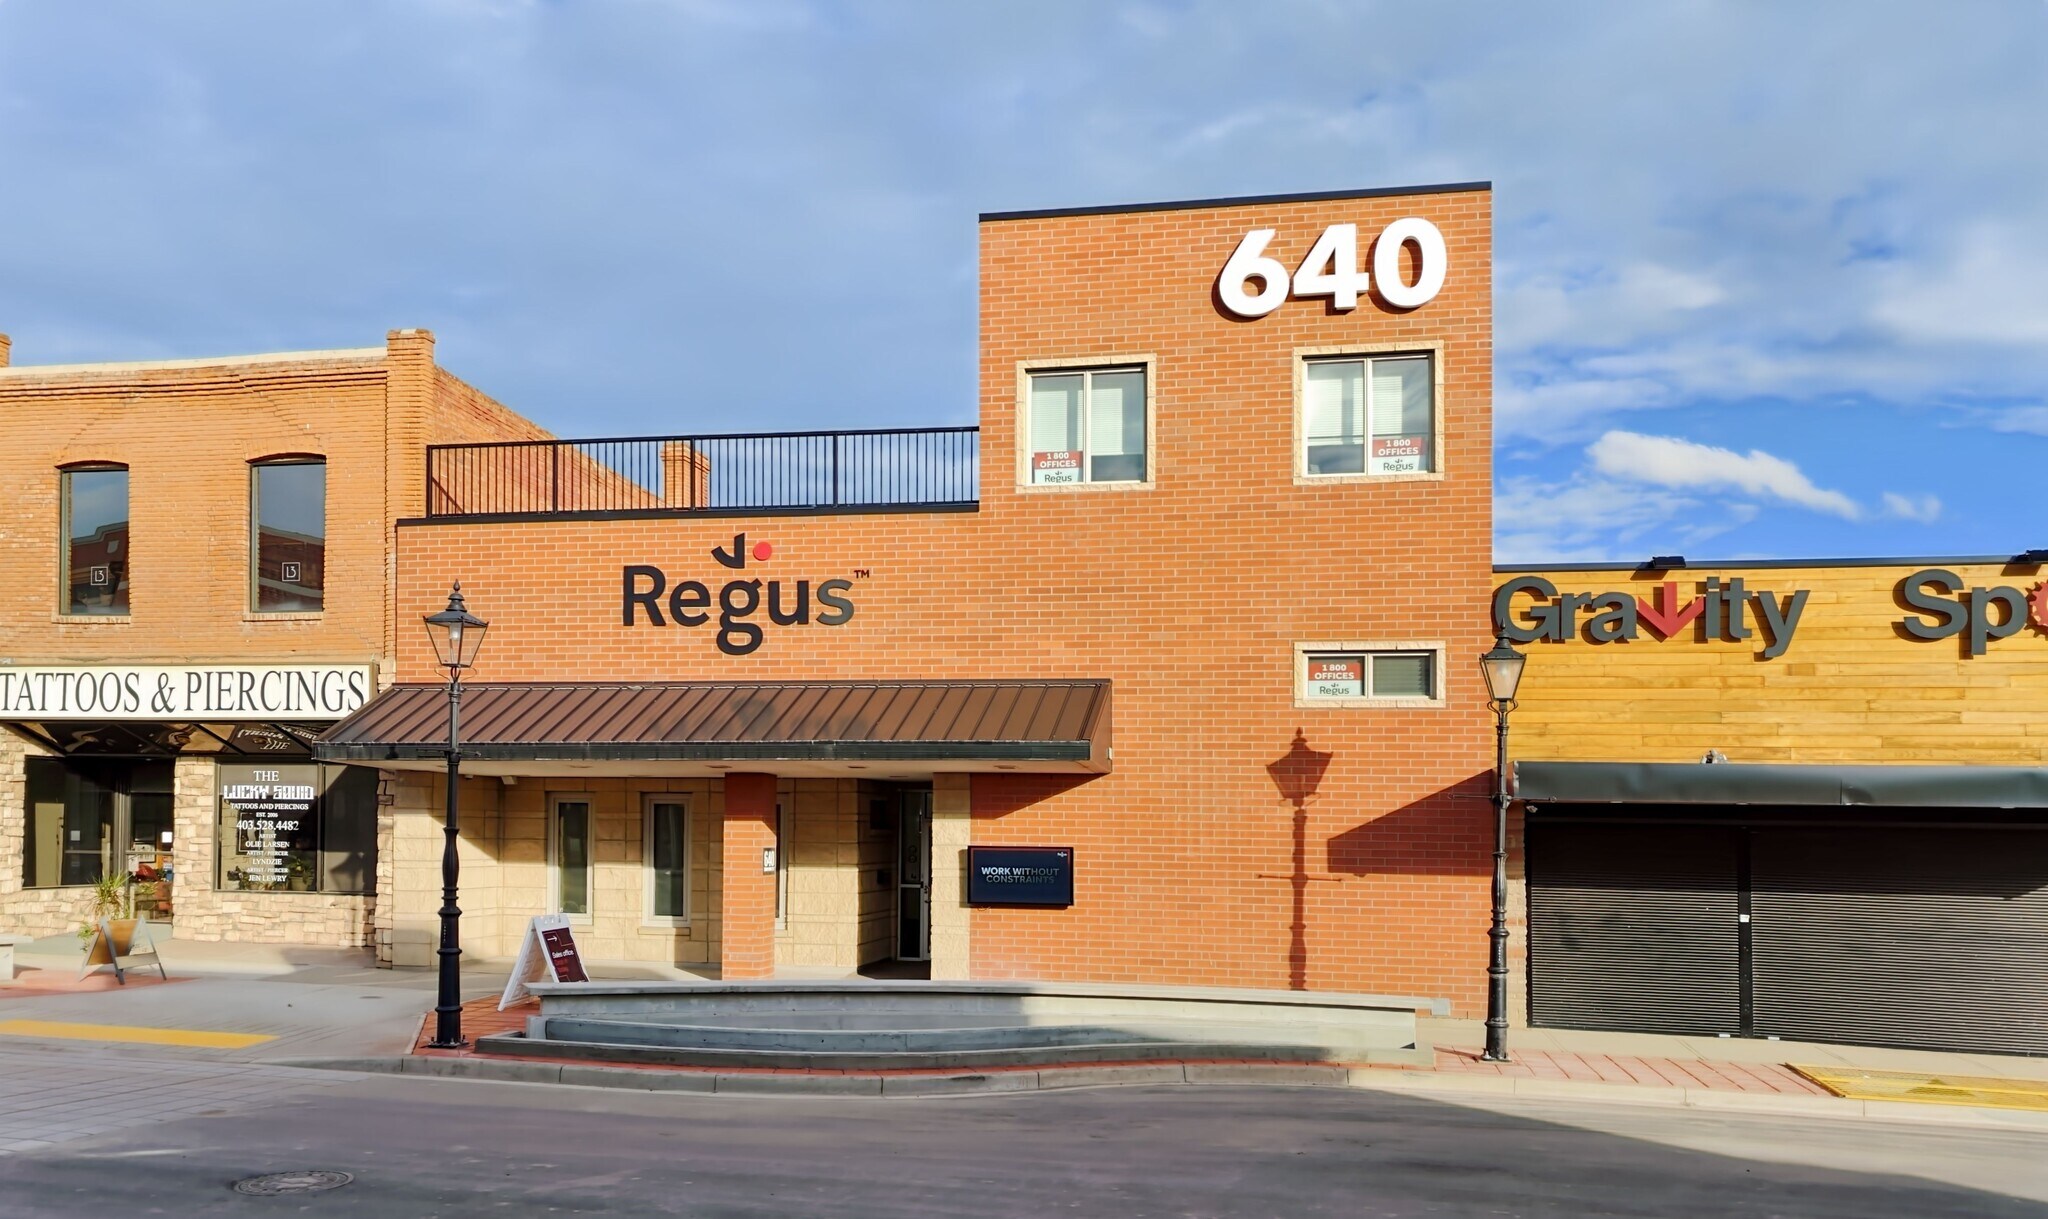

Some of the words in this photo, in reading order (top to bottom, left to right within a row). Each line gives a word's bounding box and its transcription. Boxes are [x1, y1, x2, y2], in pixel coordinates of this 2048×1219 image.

[1219, 217, 1447, 317] 640
[1393, 439, 1411, 447] 800
[1053, 452, 1069, 460] 800
[1378, 447, 1419, 456] OFFICES
[1040, 460, 1077, 468] OFFICES
[1383, 462, 1414, 472] Regus
[1044, 474, 1072, 483] Regus
[623, 565, 854, 655] Regus
[1314, 672, 1354, 680] OFFICES
[0, 672, 140, 712] TATTOOS
[151, 672, 176, 713] &
[184, 670, 365, 712] PIERCINGS
[1319, 686, 1350, 696] Regus
[253, 770, 280, 782] THE
[224, 785, 269, 799] LUCKY
[236, 820, 299, 831] 403.528.4482
[981, 867, 1010, 875] WORK
[1013, 868, 1059, 876] WITHOUT
[986, 875, 1055, 883] CONSTRAINTS
